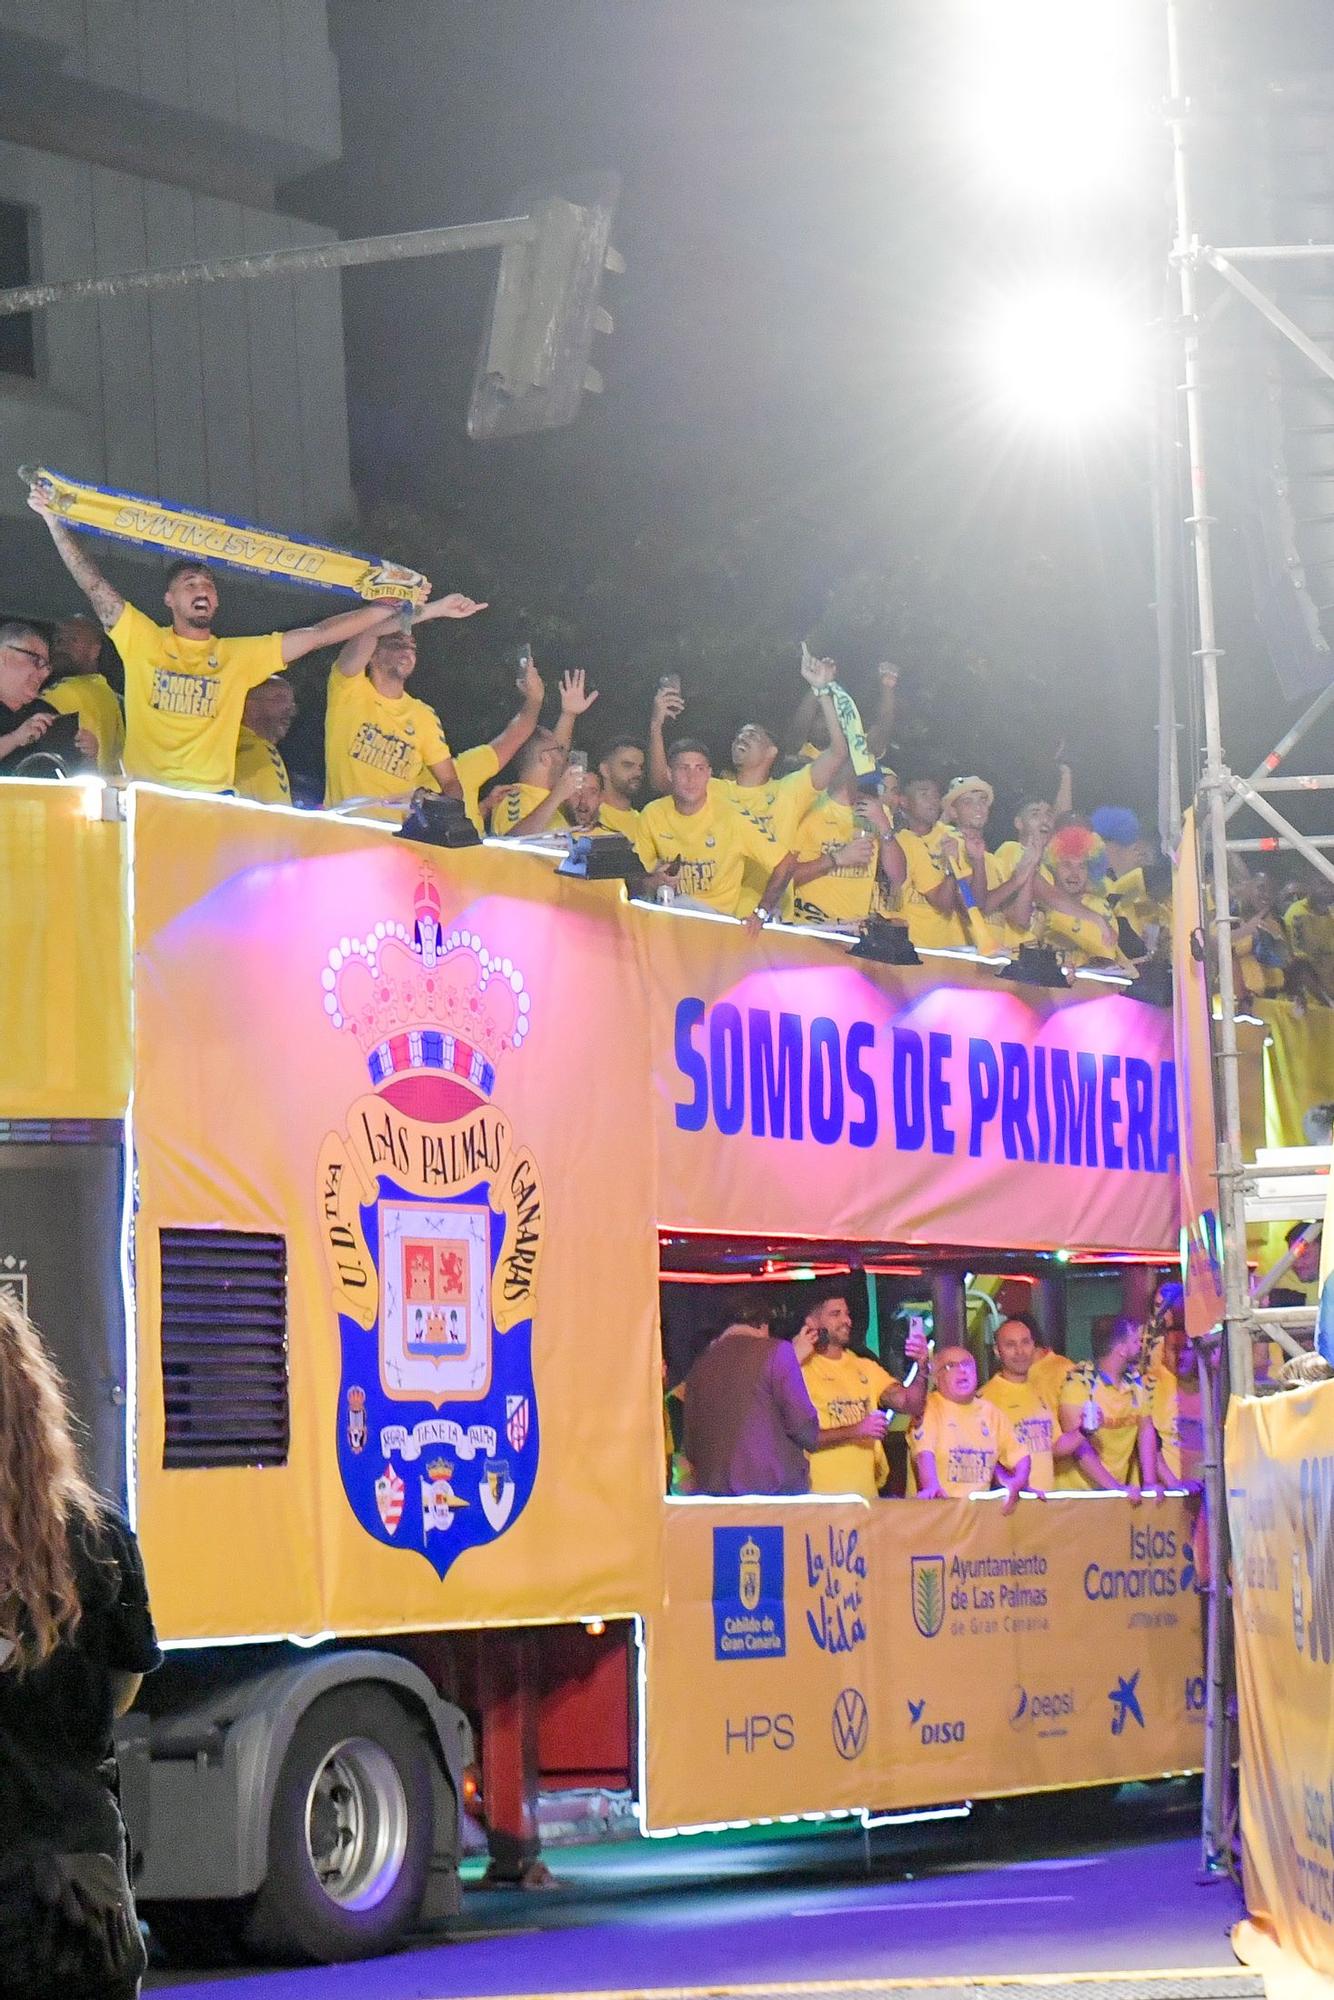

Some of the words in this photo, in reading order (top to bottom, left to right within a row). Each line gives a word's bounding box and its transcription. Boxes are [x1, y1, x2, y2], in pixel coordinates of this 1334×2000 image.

[675, 997, 878, 1147] SOMOS
[893, 1027, 955, 1154] DE
[969, 1037, 1180, 1174] PRIMERA
[361, 1112, 409, 1175] LAS
[421, 1118, 504, 1184] PALMAS
[504, 1159, 542, 1301] CANARIAS
[805, 1533, 824, 1588] La
[1130, 1524, 1176, 1560] Islas
[825, 1568, 840, 1599] de
[950, 1551, 1048, 1585] Ayuntamiento
[1085, 1562, 1176, 1600] Canarias
[951, 1586, 968, 1610] de
[973, 1586, 995, 1609] Las
[1000, 1582, 1048, 1607] Palmas
[806, 1595, 866, 1654] Vida
[726, 1713, 795, 1754] HPS
